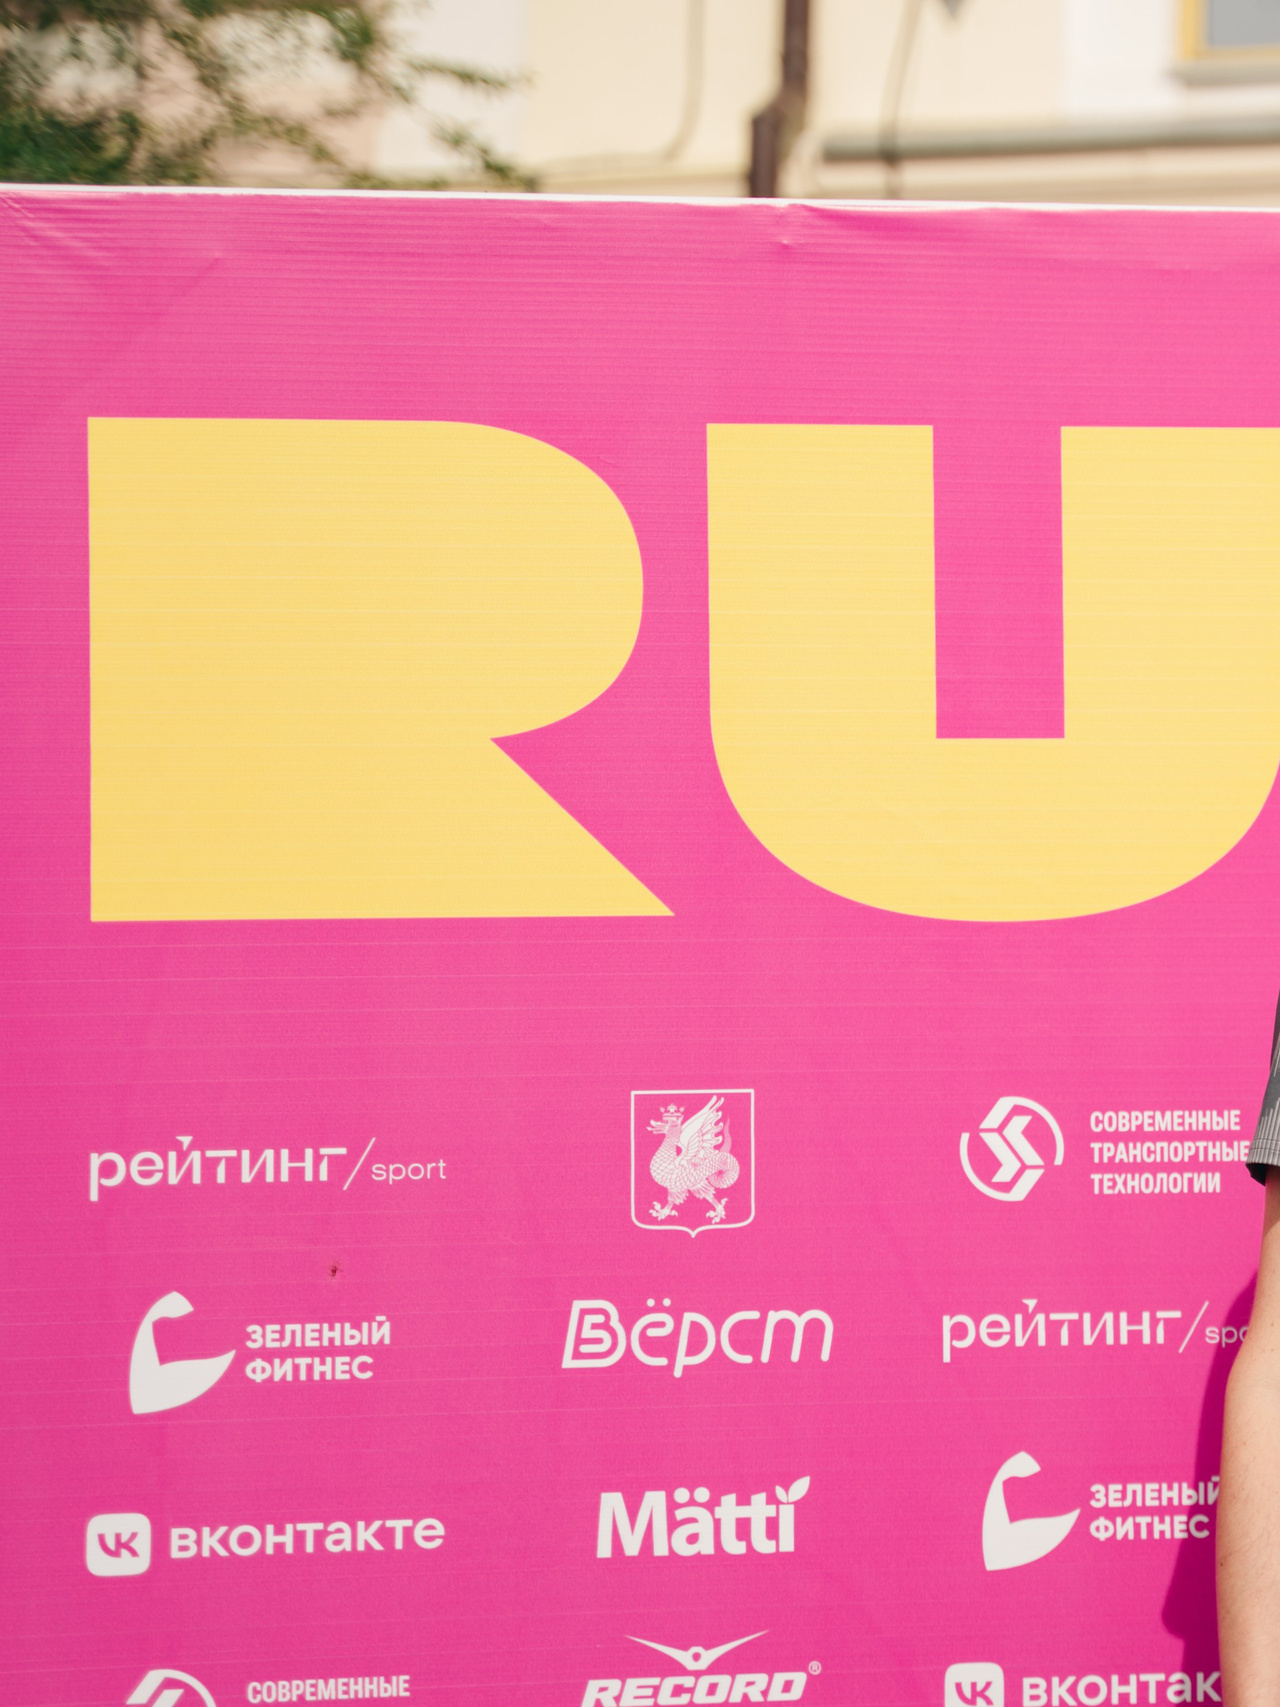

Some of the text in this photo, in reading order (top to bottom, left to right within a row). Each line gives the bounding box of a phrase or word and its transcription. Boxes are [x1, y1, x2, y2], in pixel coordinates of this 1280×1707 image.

[1091, 1109, 1240, 1132] СОВРЕМЕННЫЕ
[1090, 1140, 1250, 1164] ТРАНСПОРТНЫЕ
[1091, 1171, 1220, 1195] ТЕХНОЛОГИИ
[246, 1316, 391, 1349] ЗЕЛЕНЫЙ
[246, 1356, 374, 1383] ФИТНЕС
[1090, 1476, 1220, 1508] ЗЕЛЕНЫЙ
[597, 1476, 810, 1559] Mätti
[1090, 1514, 1210, 1541] ФИТНЕС
[248, 1675, 411, 1704] СОВРЕМЕННЫЕ
[581, 1671, 807, 1707] RECORD
